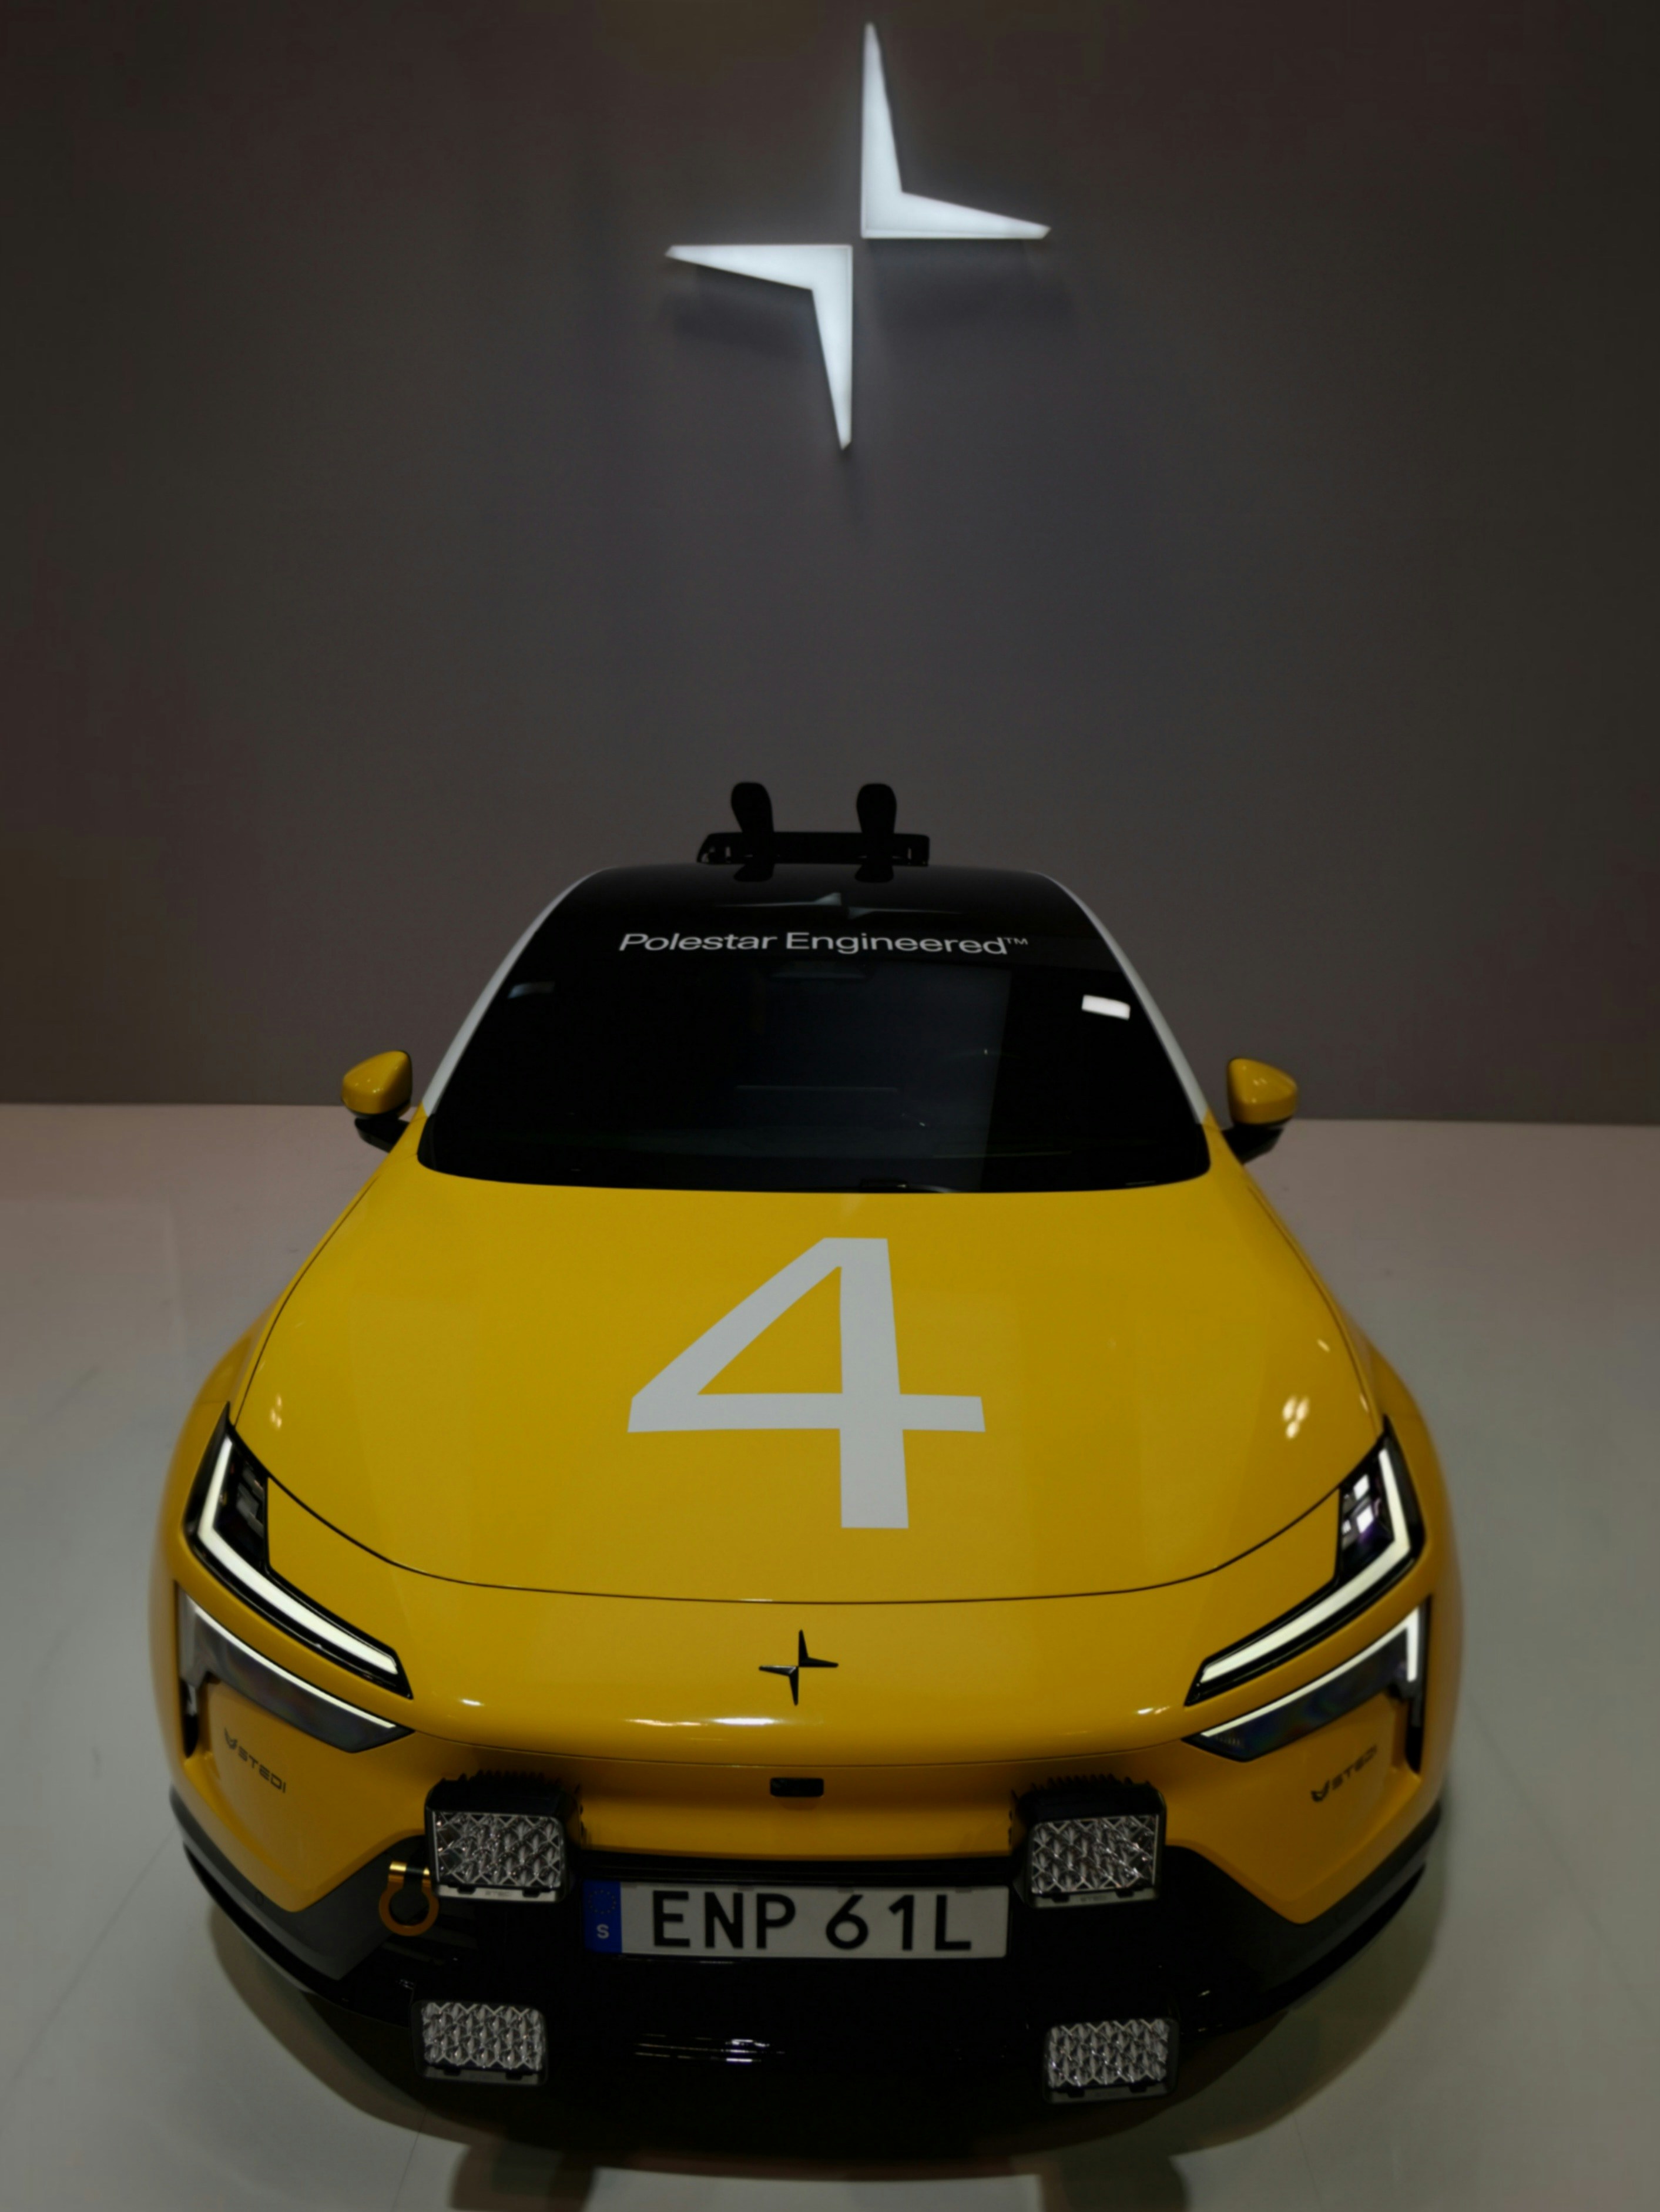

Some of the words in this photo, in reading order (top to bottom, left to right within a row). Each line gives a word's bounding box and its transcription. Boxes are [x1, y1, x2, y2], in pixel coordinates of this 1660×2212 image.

[619, 932, 778, 951] Polestar
[626, 1236, 986, 1530] 4
[238, 1745, 287, 1794] STEDI
[595, 1922, 611, 1940] S
[653, 1890, 796, 1949] ENP
[826, 1894, 972, 1951] 61L
